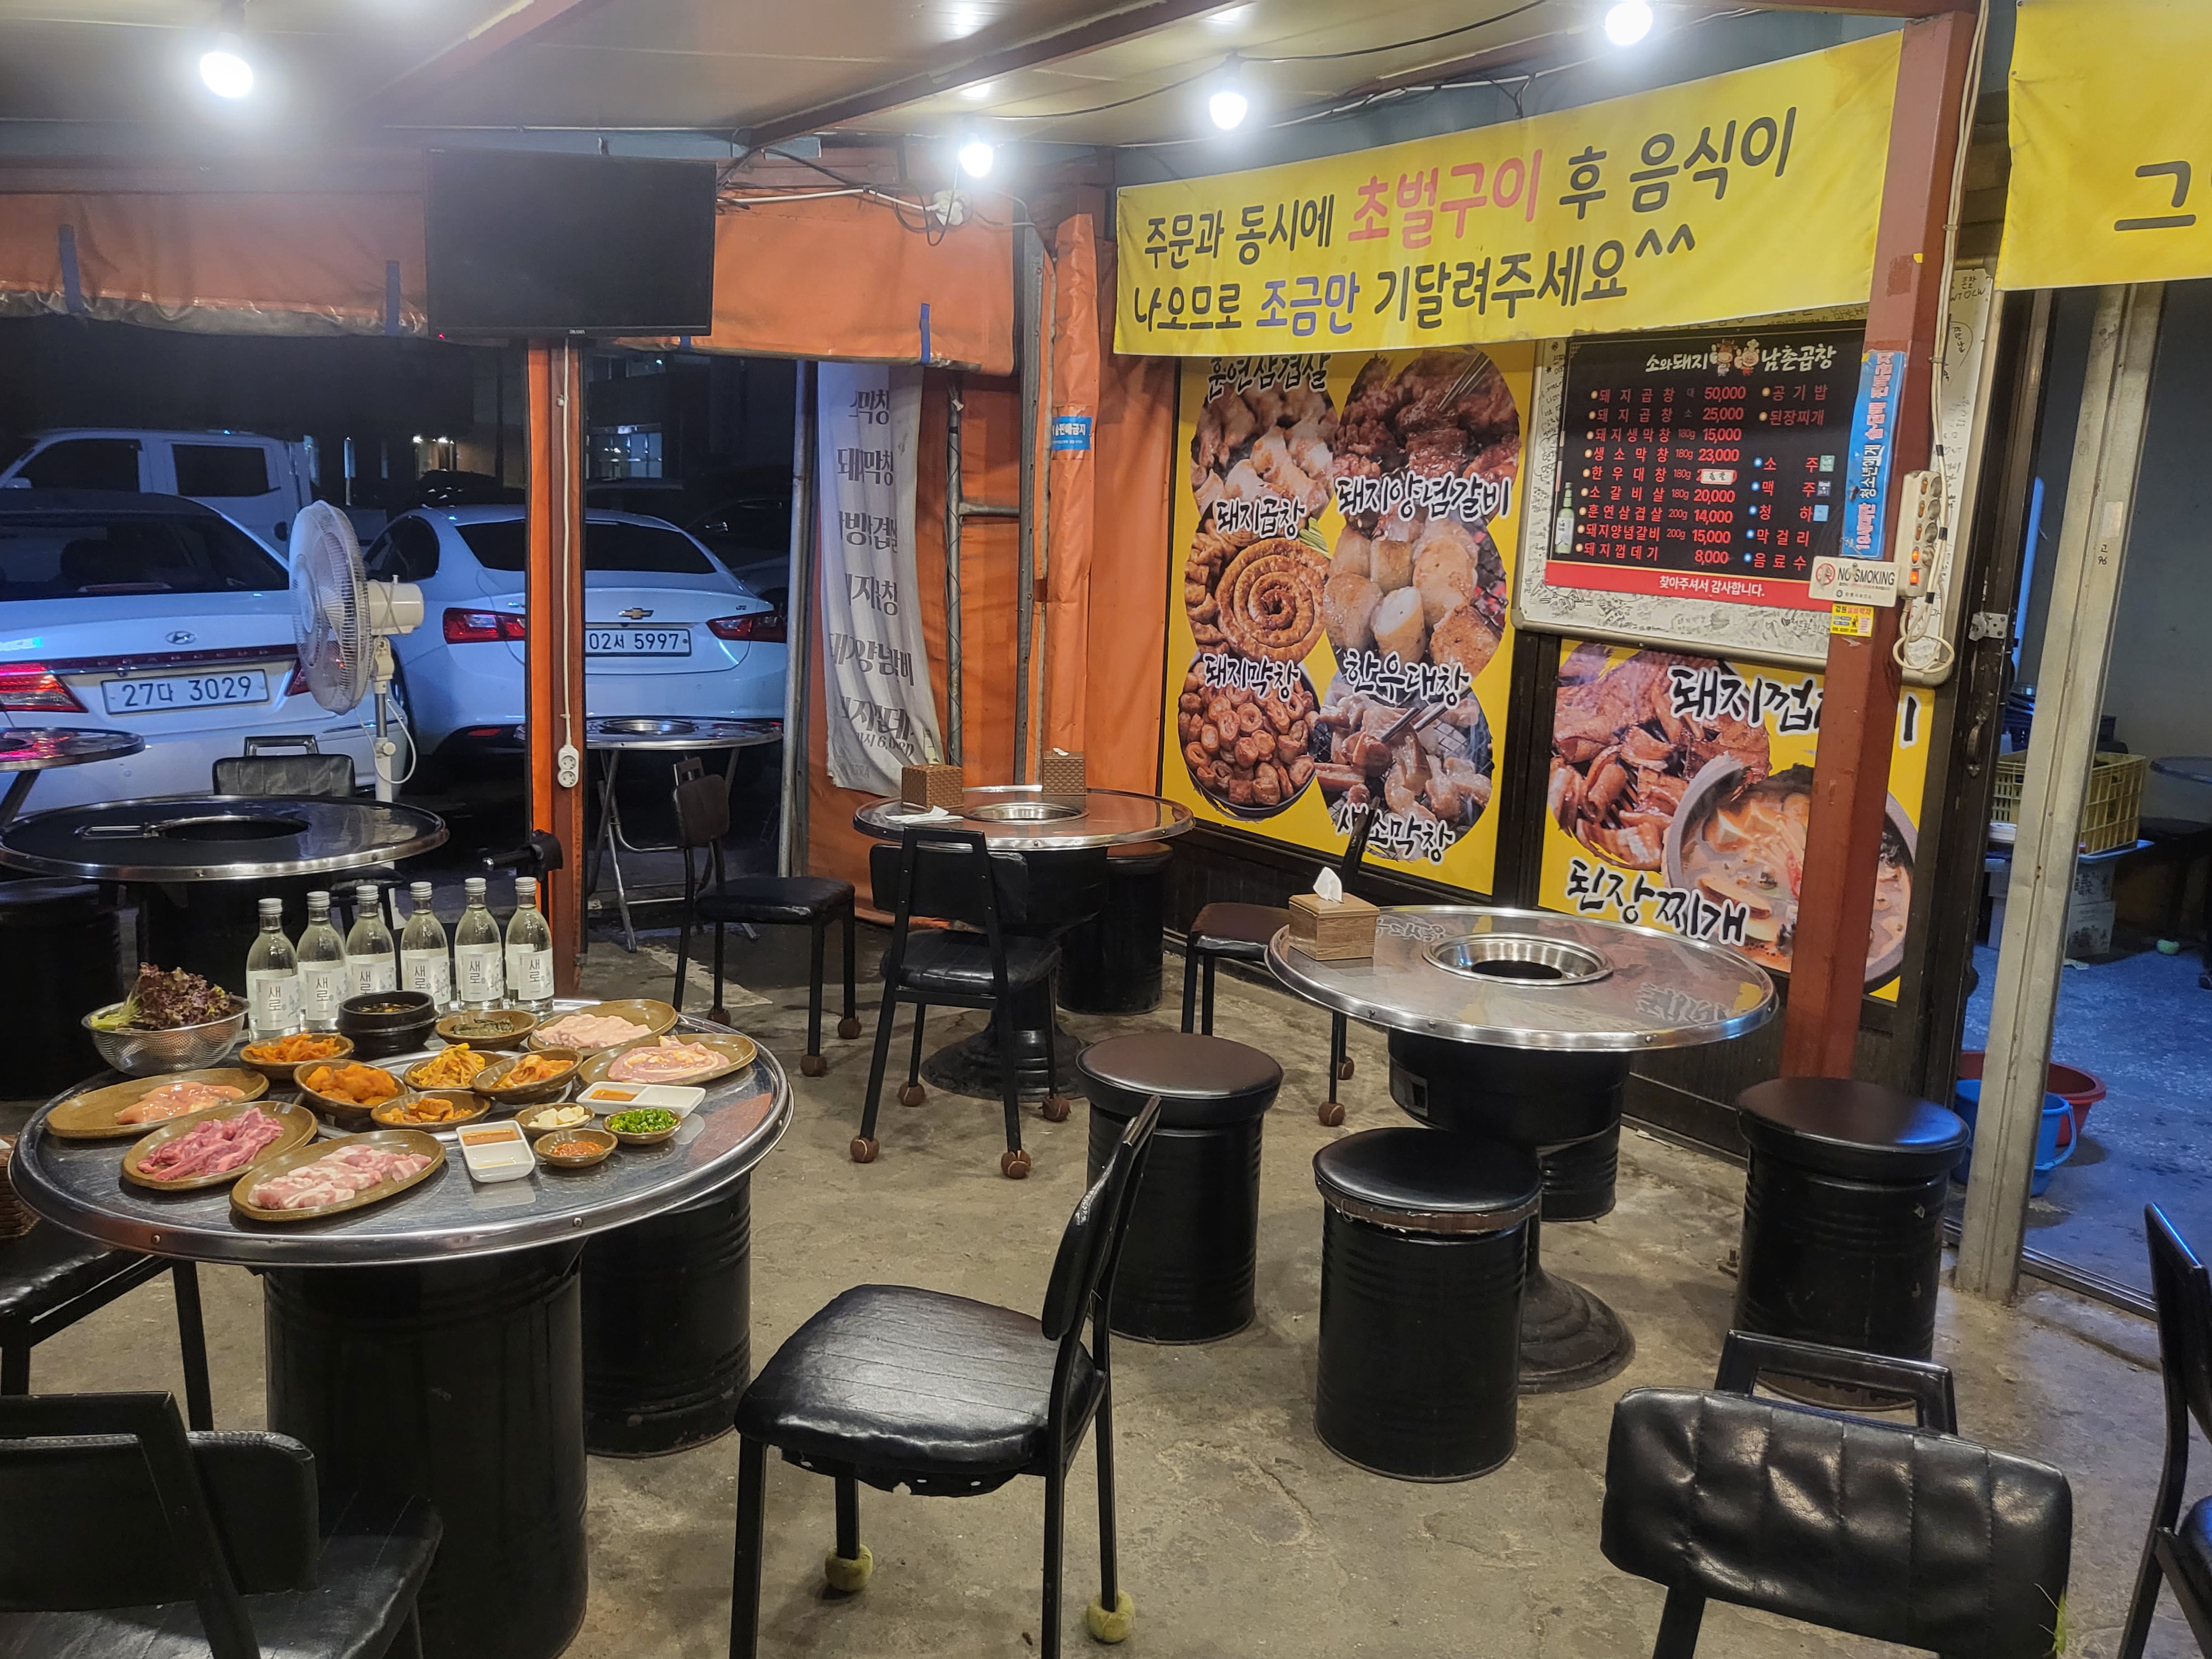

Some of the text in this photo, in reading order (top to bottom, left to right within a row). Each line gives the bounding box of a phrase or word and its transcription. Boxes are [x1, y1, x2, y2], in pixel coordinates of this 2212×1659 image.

[1145, 106, 1797, 269] 주문과 동시에 초벌구이 후 음식이
[1134, 283, 1241, 332] 나오므로
[1256, 272, 1360, 336] 조금만
[1646, 343, 1837, 373] 소와돼지 남촌곱창
[1208, 354, 1331, 403] 훈연삼겹살
[1599, 388, 1675, 403] 돼지곱창
[1704, 386, 1746, 403] 50,000
[1772, 384, 1828, 401] 공기밥
[1597, 408, 1673, 422] 돼지곱창
[1702, 406, 1744, 424] 25,000
[1770, 409, 1825, 426] 된장찌개
[1859, 444, 1882, 499] 청소년에게
[1871, 351, 1894, 399] 판매금지
[1595, 427, 1742, 444] 돼지생막창 180g 15,000
[1594, 446, 1740, 465] 생소막창 180g 23,000
[1764, 457, 1819, 473] 소주
[1592, 466, 1667, 483] 한우대창
[1673, 469, 1692, 481] 180g
[1334, 471, 1512, 521] 돼지양념갈비
[1589, 485, 1736, 505] 소갈비살 180g 20,000
[1762, 480, 1816, 497] 맥주
[1216, 497, 1307, 538] 돼지곱창
[1588, 504, 1734, 525] 훈연삼겹살 200g 14,000
[1759, 504, 1813, 523] 청하
[1585, 523, 1660, 541] 돼지양념갈비
[1666, 528, 1686, 540] 200g
[1692, 529, 1731, 546] 15,000
[1756, 528, 1810, 547] 막걸리
[1584, 542, 1729, 566] 돼지껍데기 8,000
[1754, 552, 1807, 571] 음료수
[2098, 555, 2108, 565] 96
[1660, 575, 1765, 597] 찾아주셔서 감사합니다.
[1838, 567, 1895, 586] NO SMOKING
[589, 633, 679, 650] 02서 5997
[1203, 653, 1301, 701] 돼지막창
[1344, 649, 1472, 708] 한우대창
[187, 676, 252, 701] 3029
[1566, 860, 1749, 944] 된장찌개
[414, 965, 426, 990] 새로
[469, 960, 481, 984] 새로
[529, 958, 540, 983] 새로
[268, 985, 281, 1011] 새로
[316, 977, 329, 1002] 새로
